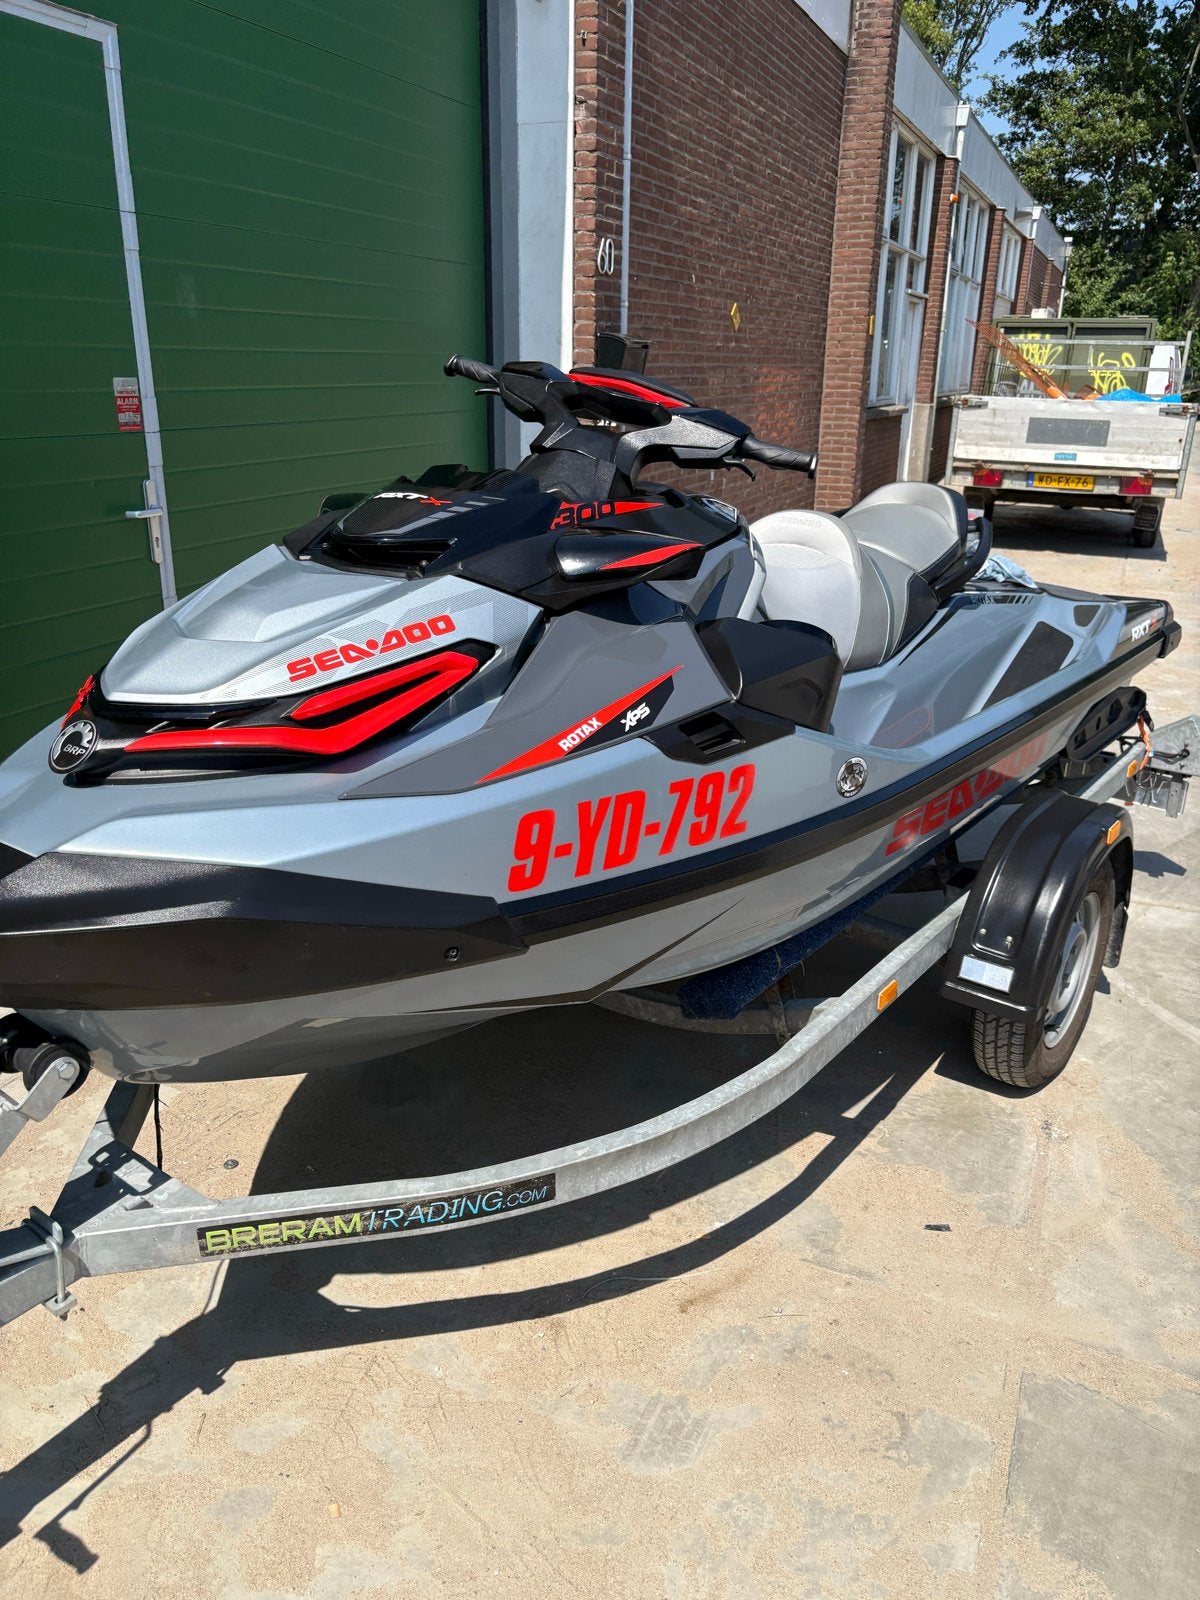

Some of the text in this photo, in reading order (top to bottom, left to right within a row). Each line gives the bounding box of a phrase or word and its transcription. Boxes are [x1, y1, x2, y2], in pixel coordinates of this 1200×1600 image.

[597, 237, 615, 275] 60
[1038, 475, 1089, 488] WD-FX-76
[620, 702, 651, 732] XPS
[63, 743, 86, 756] BRP
[557, 716, 603, 752] ROTAX
[507, 763, 756, 893] 9-YD-792
